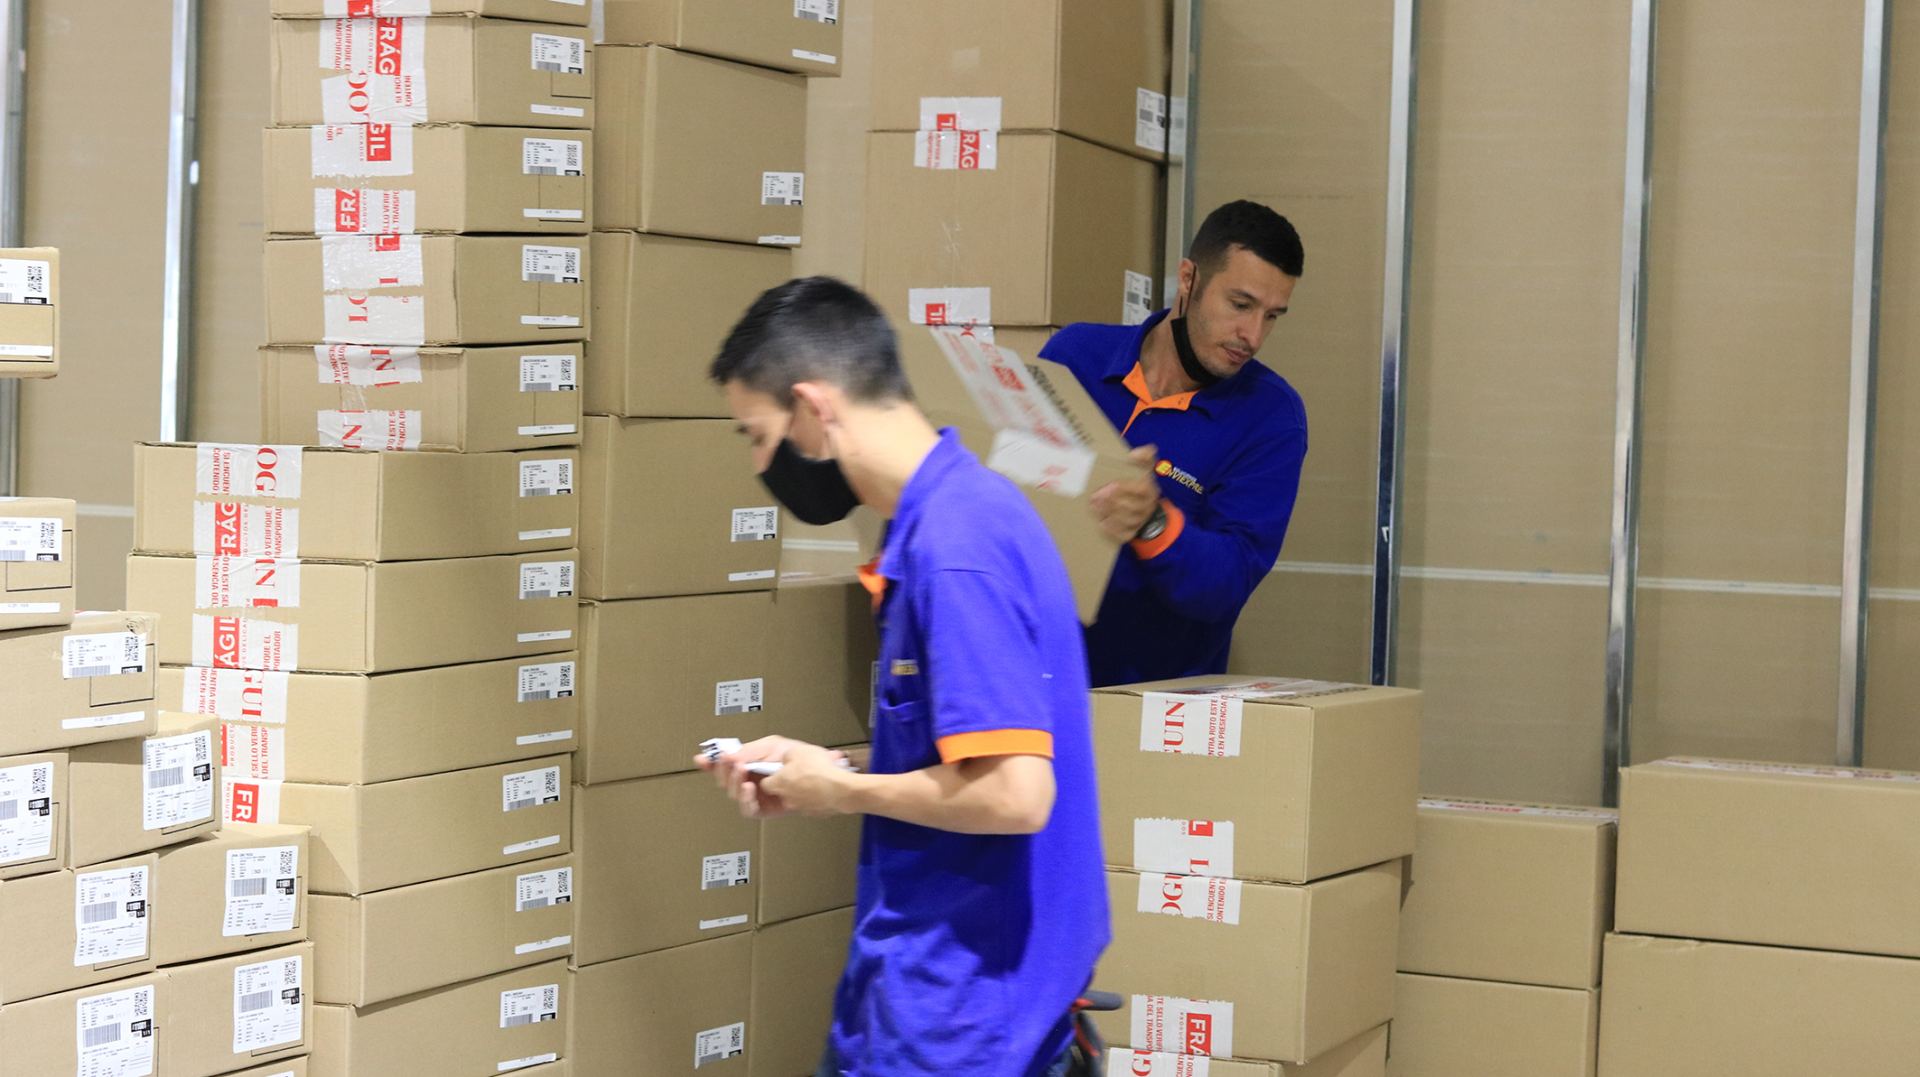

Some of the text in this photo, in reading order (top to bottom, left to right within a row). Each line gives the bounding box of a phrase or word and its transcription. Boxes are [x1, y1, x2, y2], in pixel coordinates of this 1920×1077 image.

[256, 447, 278, 498] OG
[211, 592, 219, 606] DEL
[264, 635, 271, 644] EL
[1210, 699, 1218, 716] ESTE
[1163, 700, 1185, 753] UIN
[1219, 701, 1227, 739] PRESENCIA
[1218, 740, 1225, 749] EN
[261, 761, 269, 774] DEL
